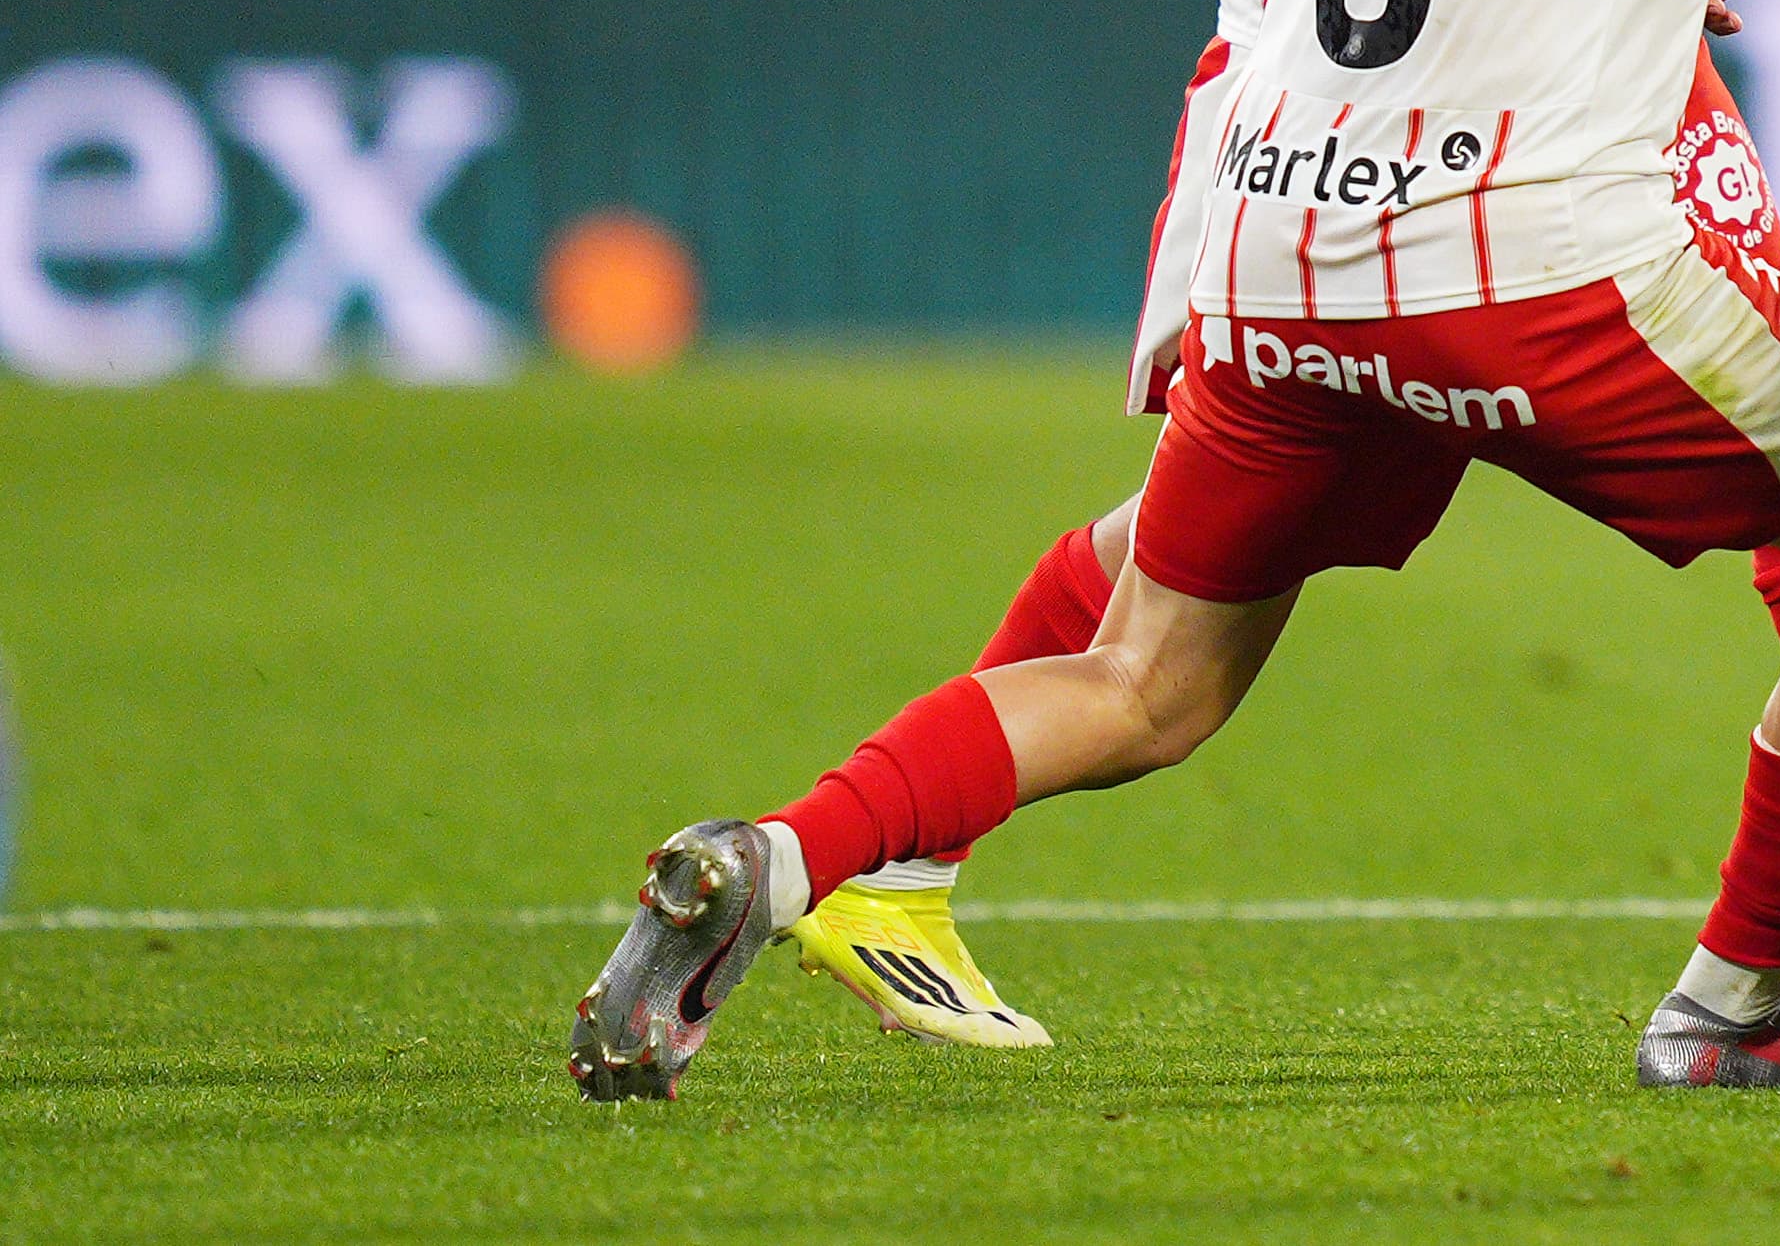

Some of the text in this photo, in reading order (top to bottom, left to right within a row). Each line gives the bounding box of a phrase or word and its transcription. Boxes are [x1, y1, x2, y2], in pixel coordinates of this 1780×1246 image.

[1215, 123, 1428, 206] Marlex
[1742, 229, 1763, 248] de
[1242, 325, 1537, 430] parlem
